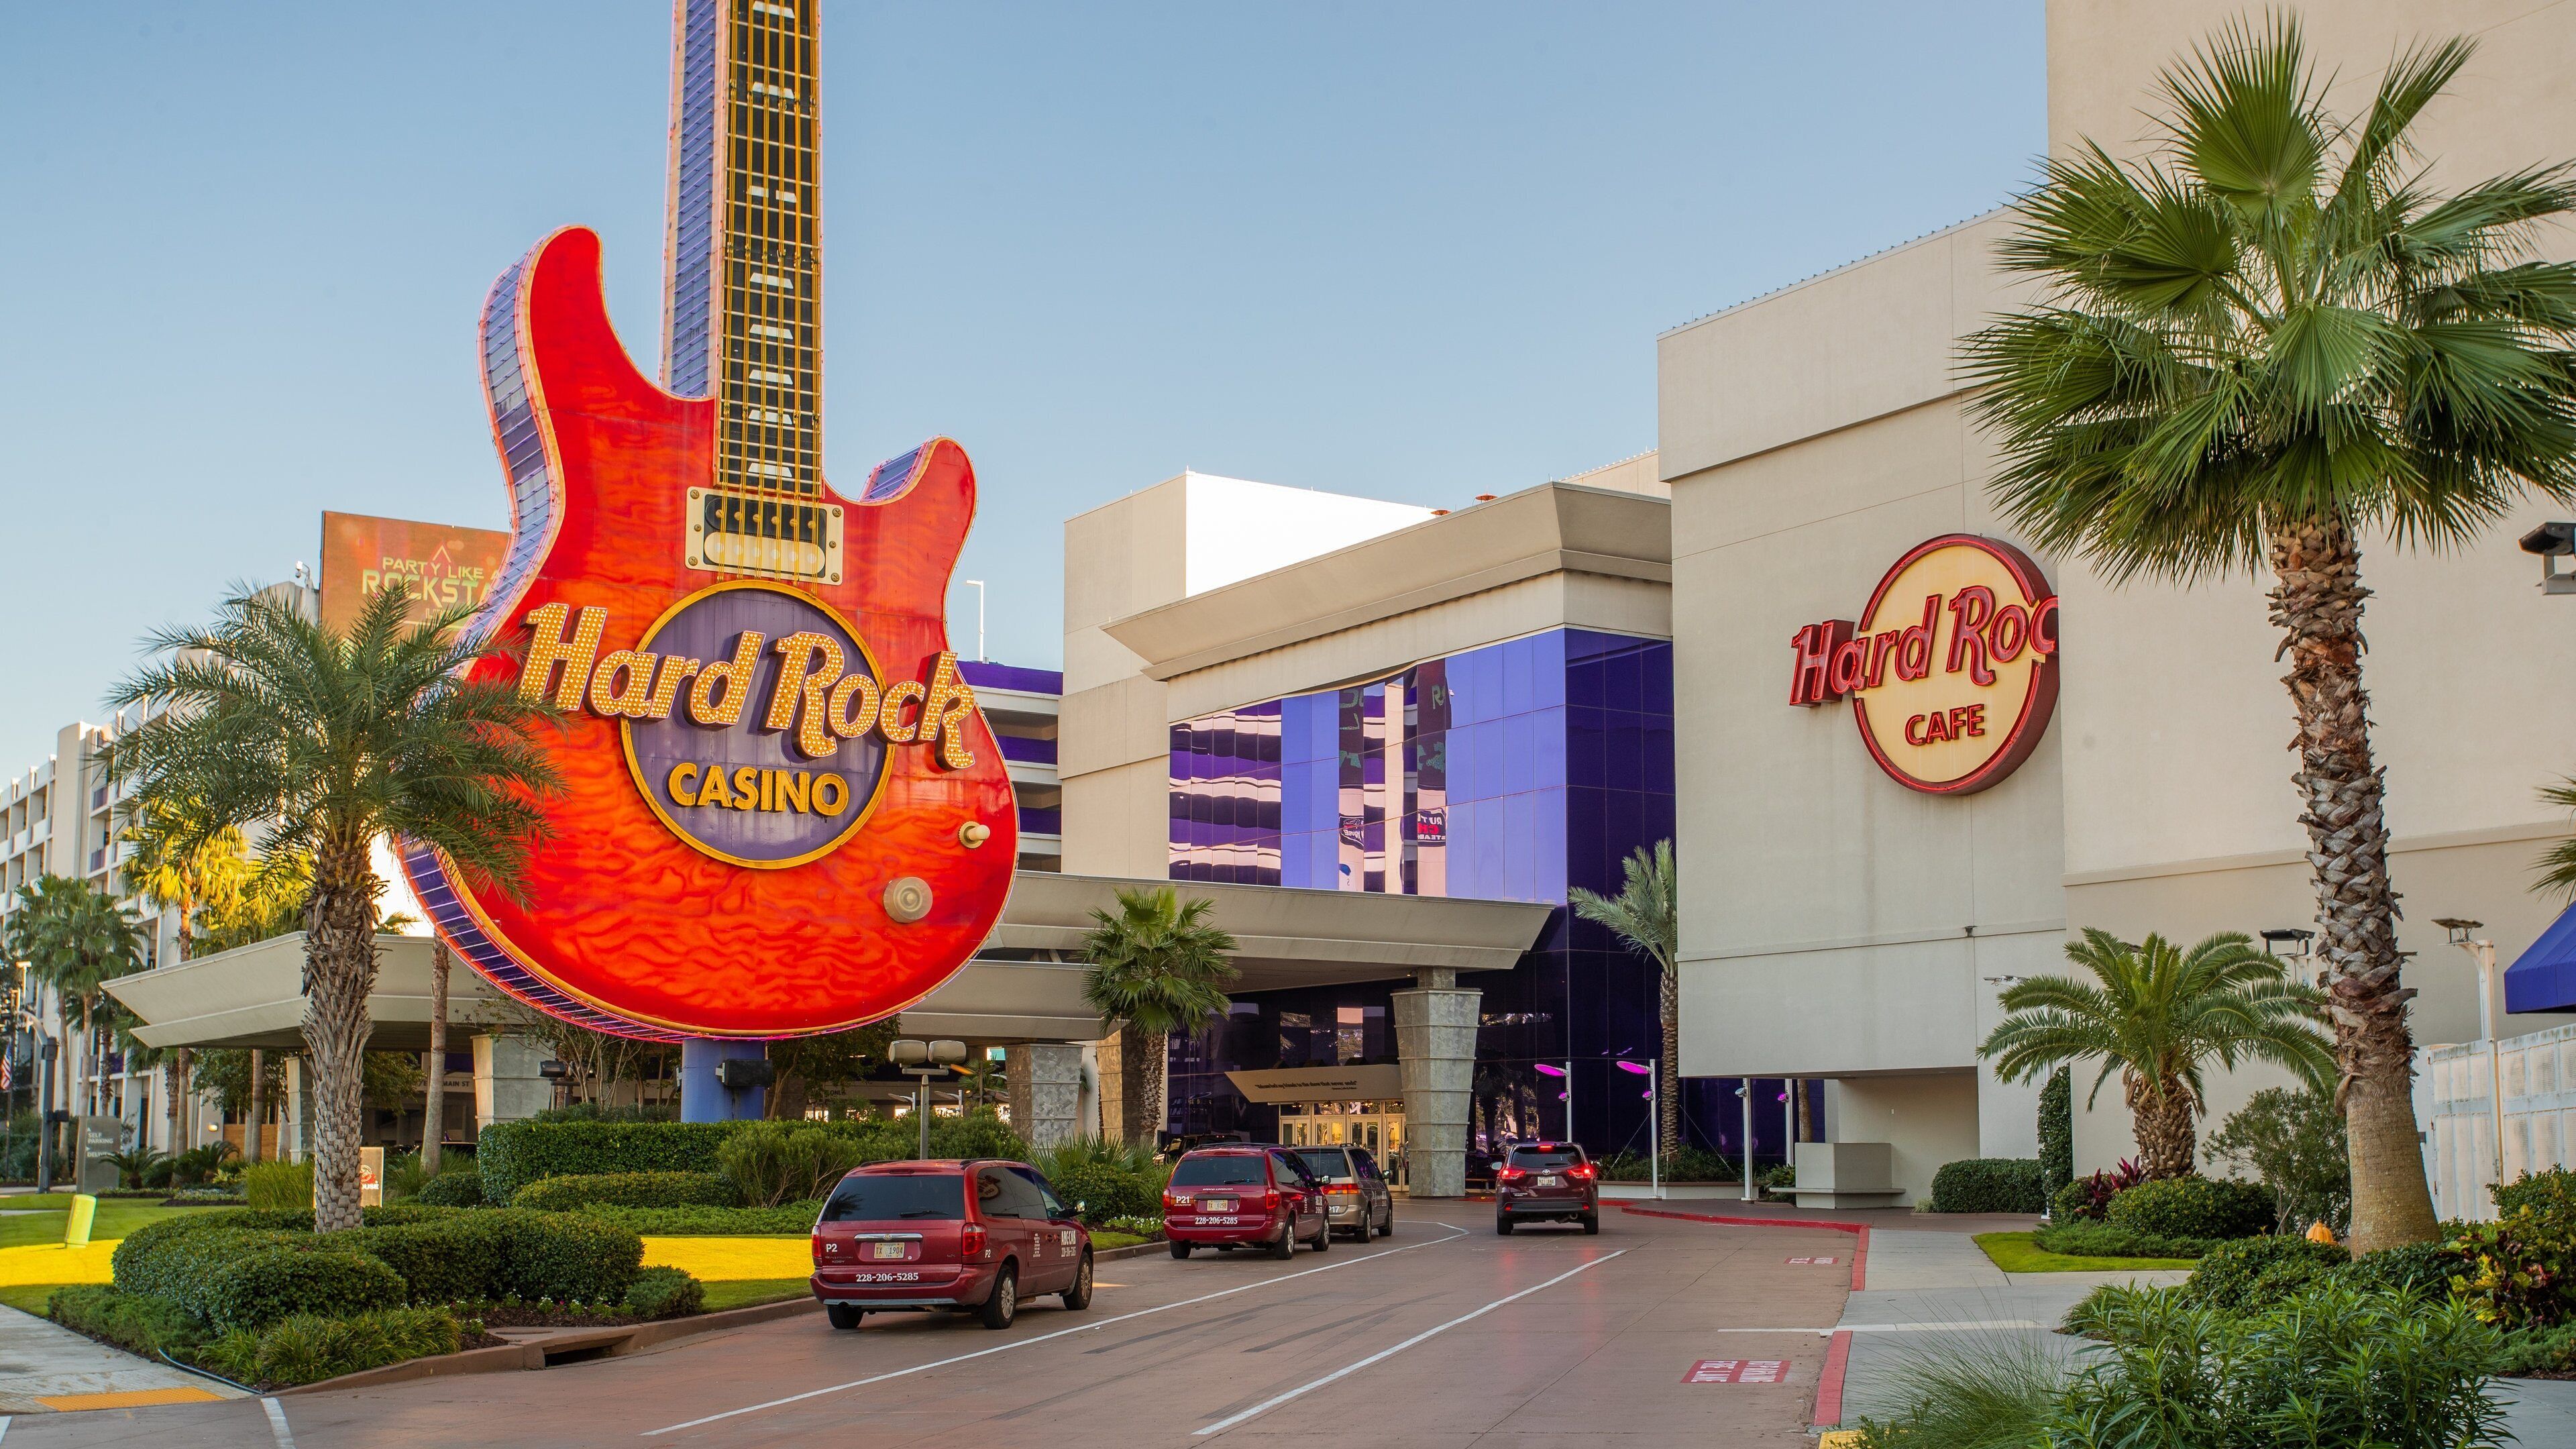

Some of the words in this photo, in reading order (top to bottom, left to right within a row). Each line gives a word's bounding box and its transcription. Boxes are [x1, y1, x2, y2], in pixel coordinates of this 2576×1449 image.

[382, 557, 441, 576] PARTY
[448, 566, 484, 581] LIKE
[1789, 594, 1942, 708] Hard
[1945, 585, 2058, 686] Roc
[519, 602, 767, 726] Hard
[775, 631, 975, 770] Rock
[1904, 704, 1985, 746] CAFE
[667, 762, 850, 816] CASINO
[1176, 1195, 1190, 1204] P21
[1195, 1217, 1238, 1225] 228-206-5285
[826, 1244, 838, 1252] P2
[890, 1246, 903, 1254] 1904
[985, 1249, 991, 1258] P2
[856, 1273, 919, 1282] 228-206-5285
